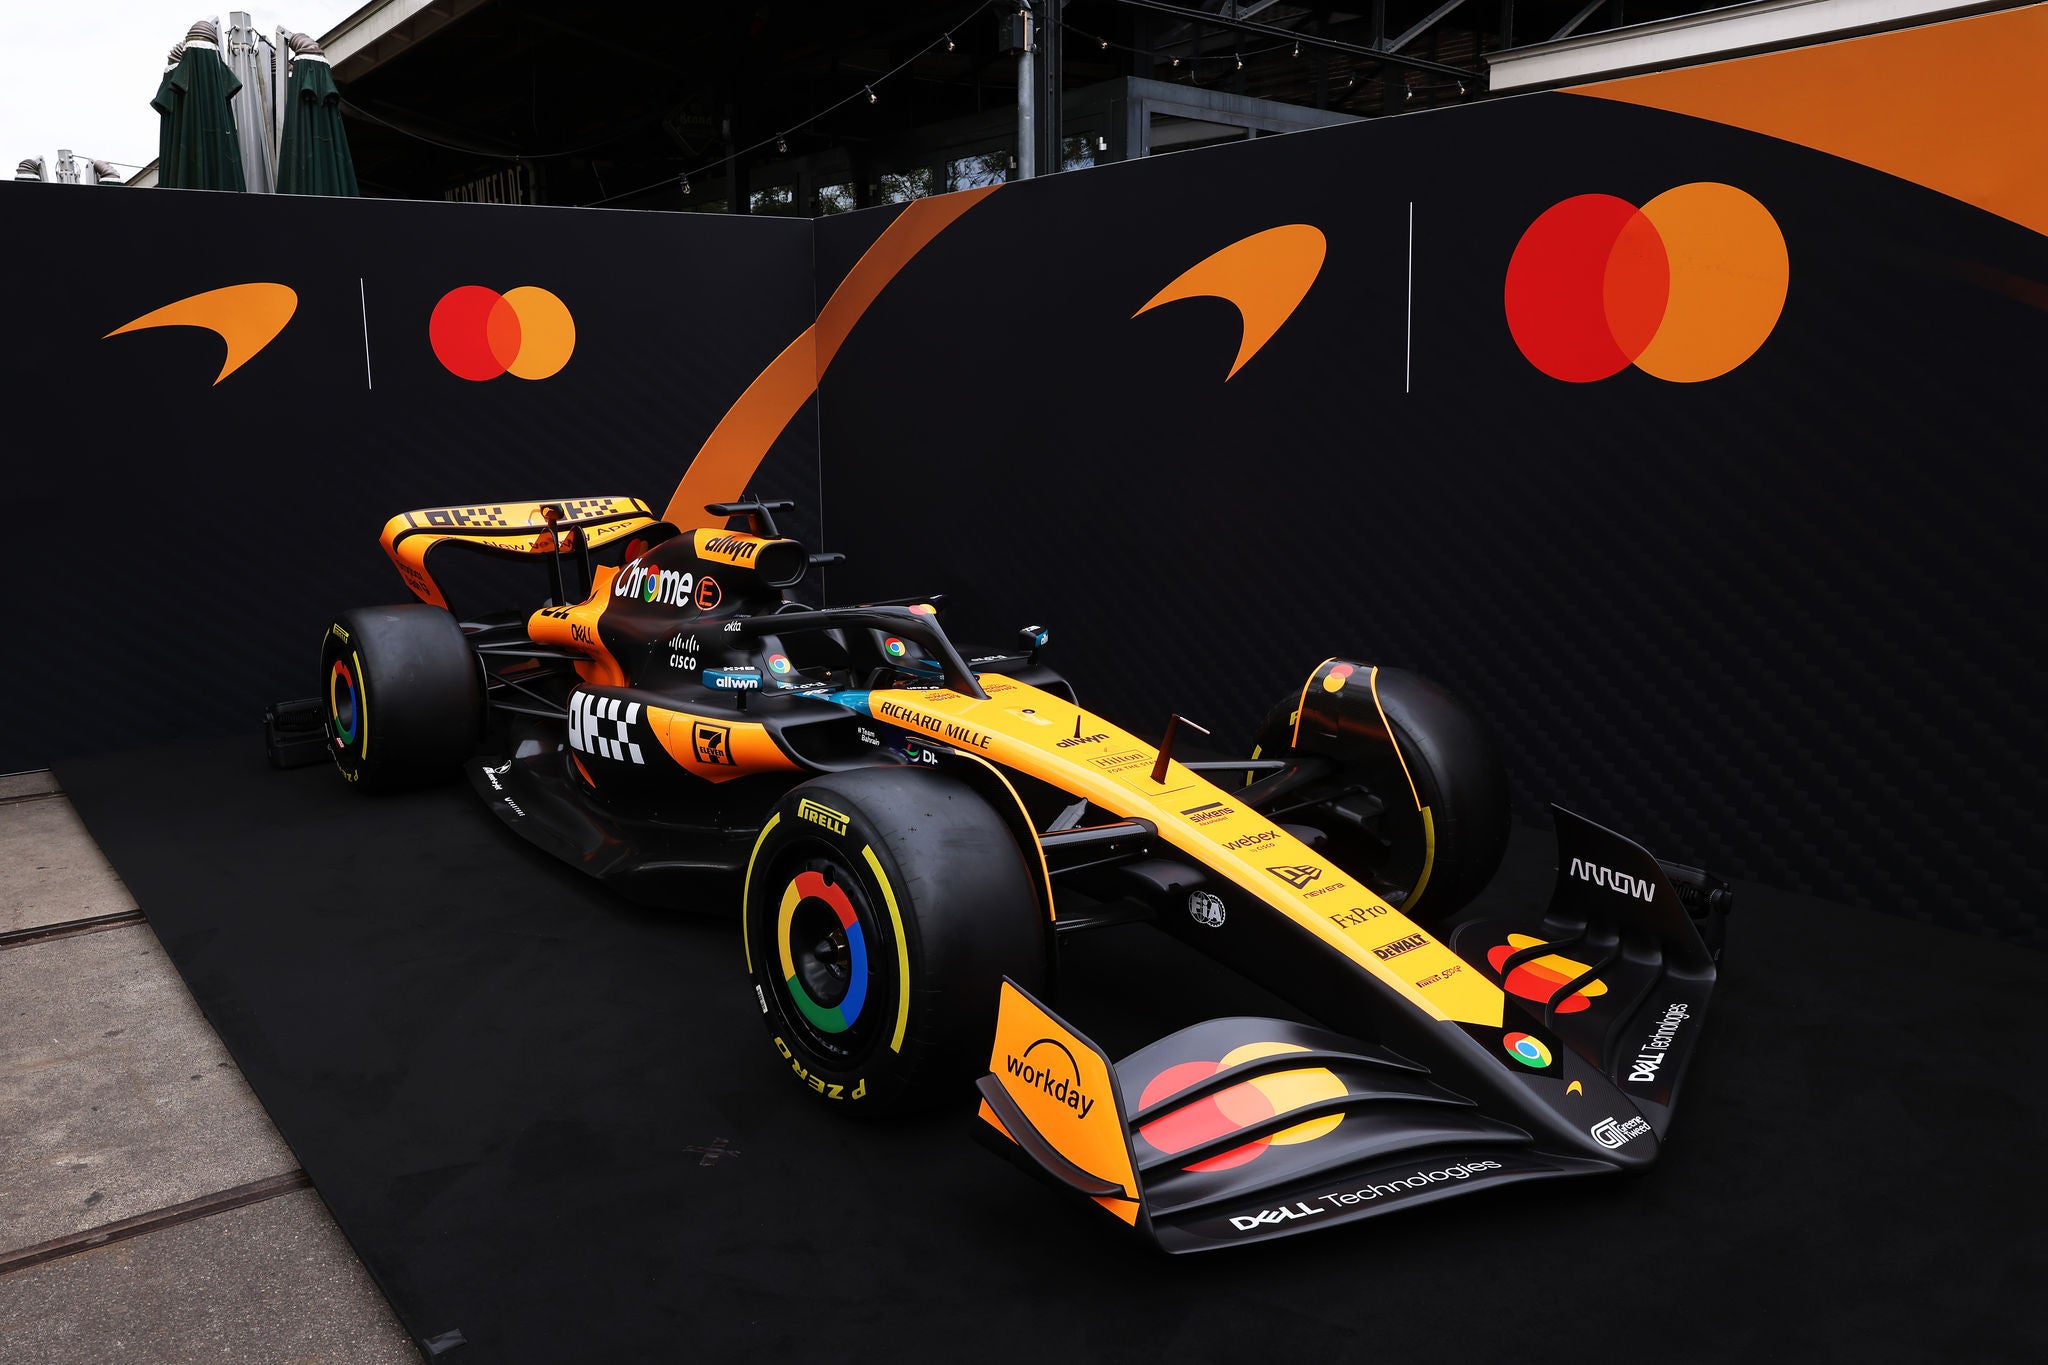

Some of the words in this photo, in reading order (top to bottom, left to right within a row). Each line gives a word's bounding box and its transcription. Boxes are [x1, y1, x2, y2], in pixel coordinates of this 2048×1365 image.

[424, 507, 507, 526] OKX
[596, 521, 632, 536] App
[704, 535, 758, 561] allwyn
[614, 557, 693, 608] Chrome
[699, 580, 714, 607] E
[571, 623, 595, 645] DELL
[724, 620, 742, 632] okta
[715, 676, 758, 690] allwyn
[568, 690, 645, 765] OKX
[880, 701, 943, 733] RICHARD
[944, 723, 993, 750] MILLE
[699, 728, 722, 764] 7
[861, 734, 881, 747] Bahrain
[1056, 733, 1111, 748] allwyn
[1095, 753, 1144, 767] Hilton
[797, 798, 851, 837] PIRELLI
[1189, 807, 1235, 823] sikkens
[1222, 830, 1281, 851] webex
[1570, 857, 1656, 903] ARROW
[1329, 905, 1388, 930] FxPro
[1416, 974, 1442, 988] PIRELLI
[1641, 1003, 1690, 1051] Technologies
[773, 1036, 844, 1100] ZERO
[1628, 1052, 1665, 1082] DELL
[851, 1078, 867, 1100] P
[1006, 1054, 1095, 1119] workday
[1616, 1116, 1644, 1133] Greene
[1624, 1121, 1652, 1140] Tweed
[1229, 1202, 1326, 1231] DELL
[1318, 1160, 1503, 1208] Technologies
